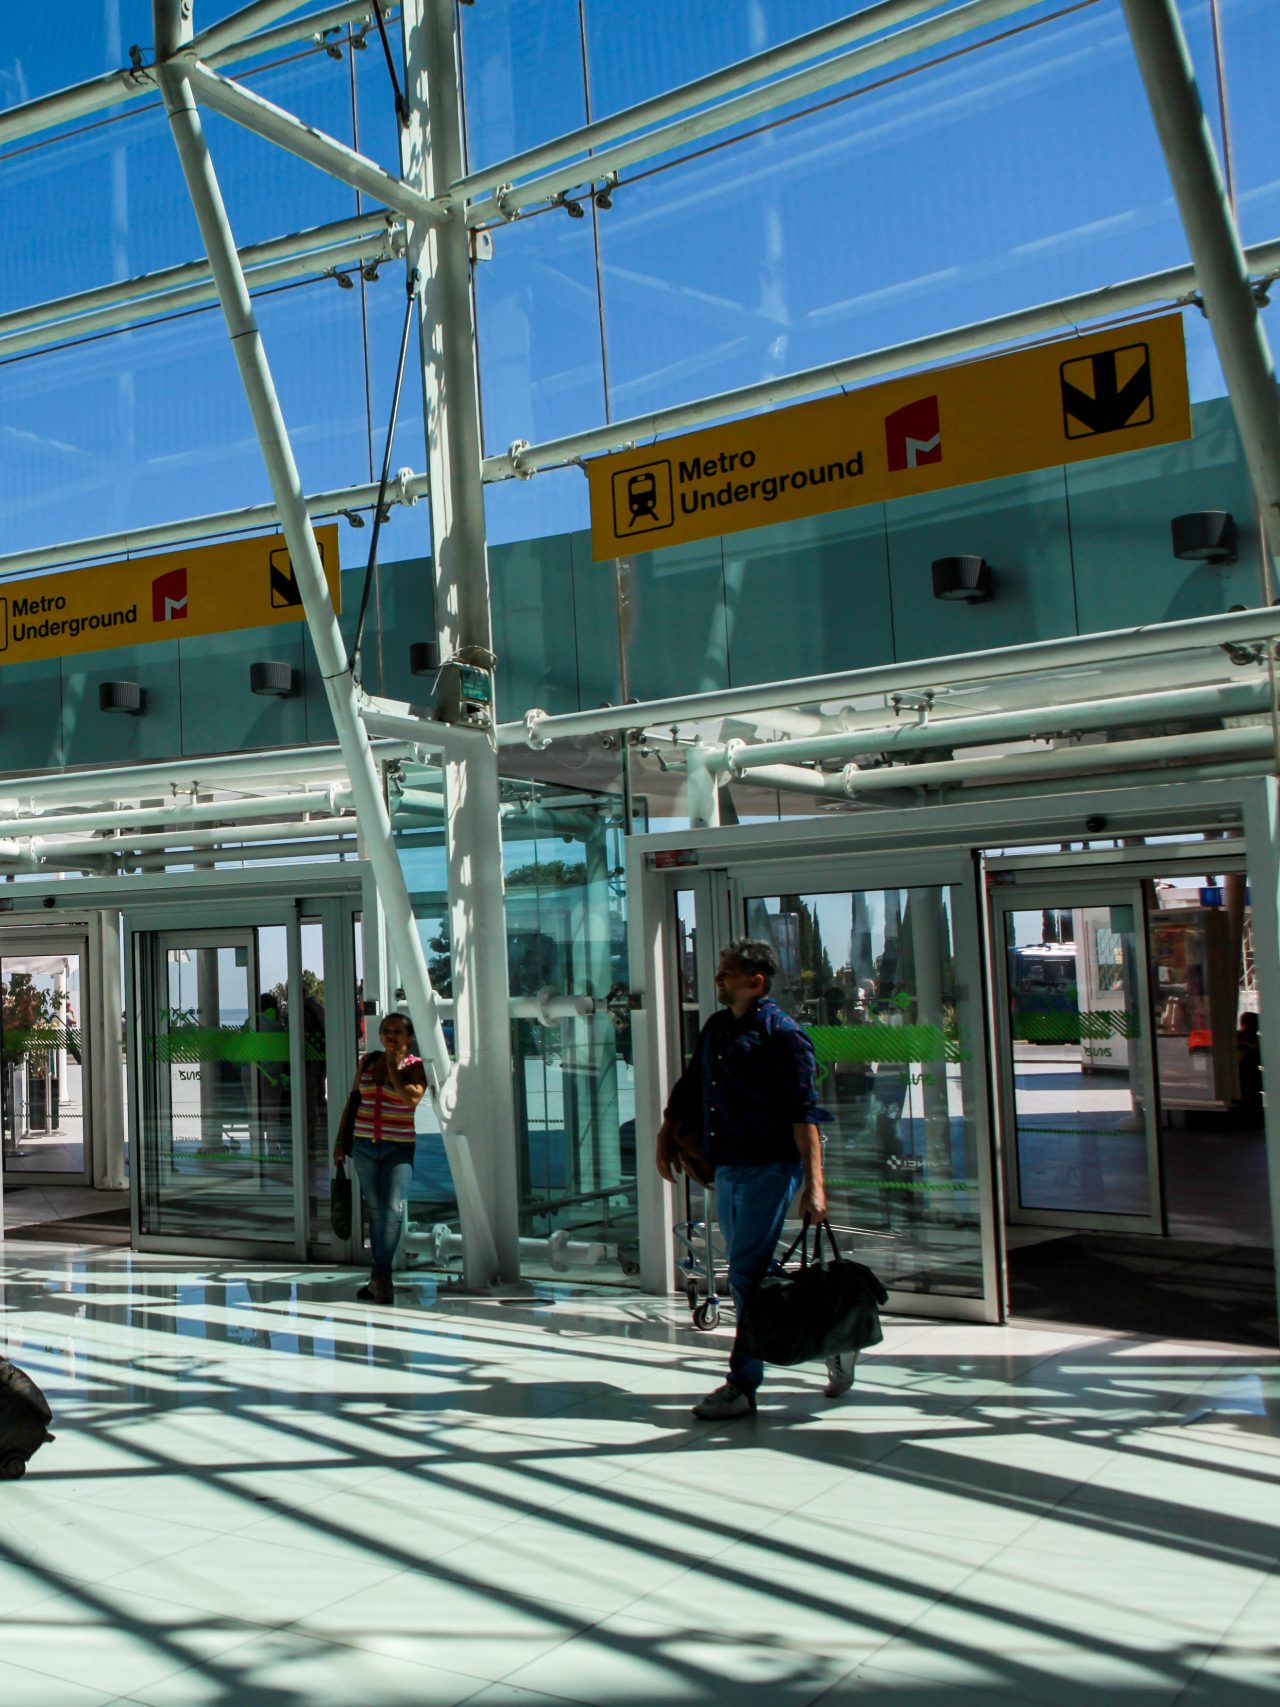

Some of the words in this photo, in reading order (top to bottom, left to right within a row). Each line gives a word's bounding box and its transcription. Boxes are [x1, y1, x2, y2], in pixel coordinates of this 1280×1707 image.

[679, 449, 756, 484] Metro
[680, 451, 864, 514] Underground
[12, 595, 66, 618] Metro
[12, 604, 137, 642] Underground
